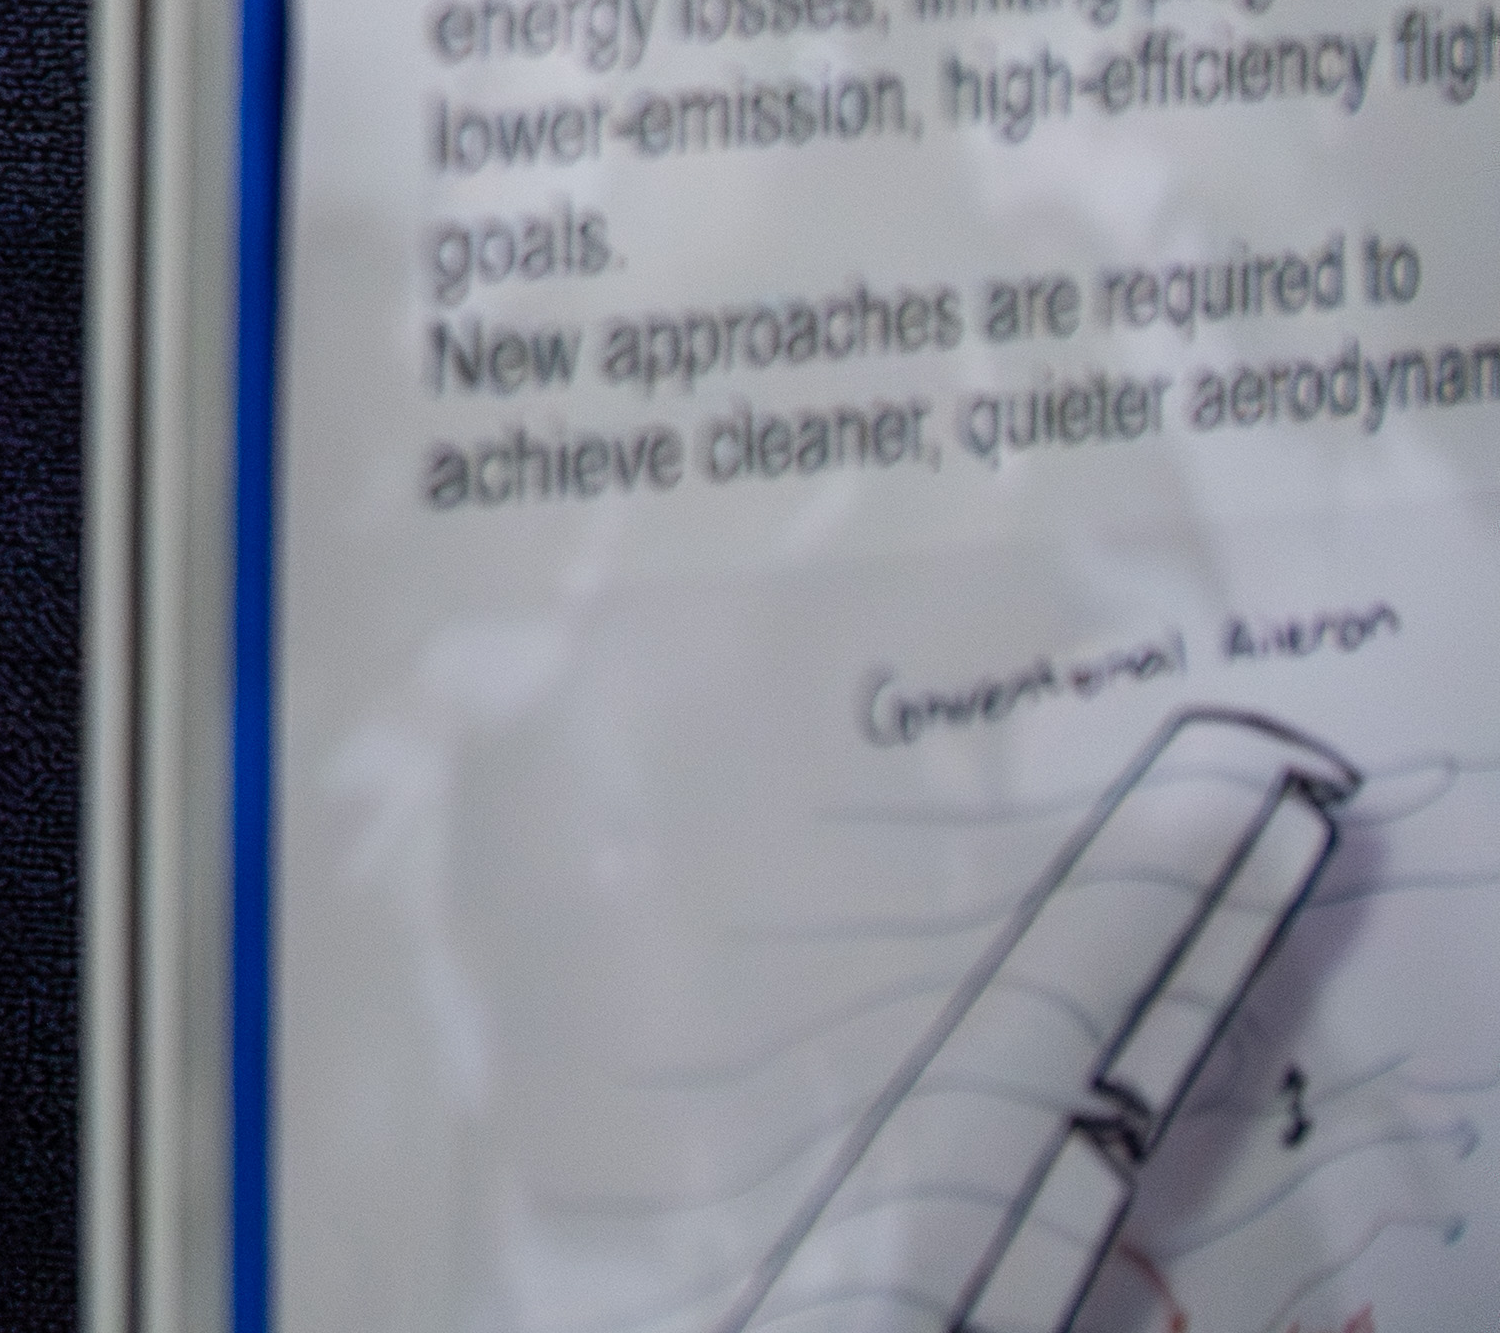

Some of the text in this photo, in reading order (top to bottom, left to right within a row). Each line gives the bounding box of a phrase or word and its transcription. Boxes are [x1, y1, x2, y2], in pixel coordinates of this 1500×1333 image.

[430, 65, 925, 176] lower-emission,
[943, 30, 1378, 145] high-efficiency
[426, 230, 1422, 396] New approaches are required to
[432, 191, 628, 308] goals.
[423, 416, 686, 513] achieve
[705, 395, 942, 488] cleaner,
[964, 368, 1172, 468] quieter
